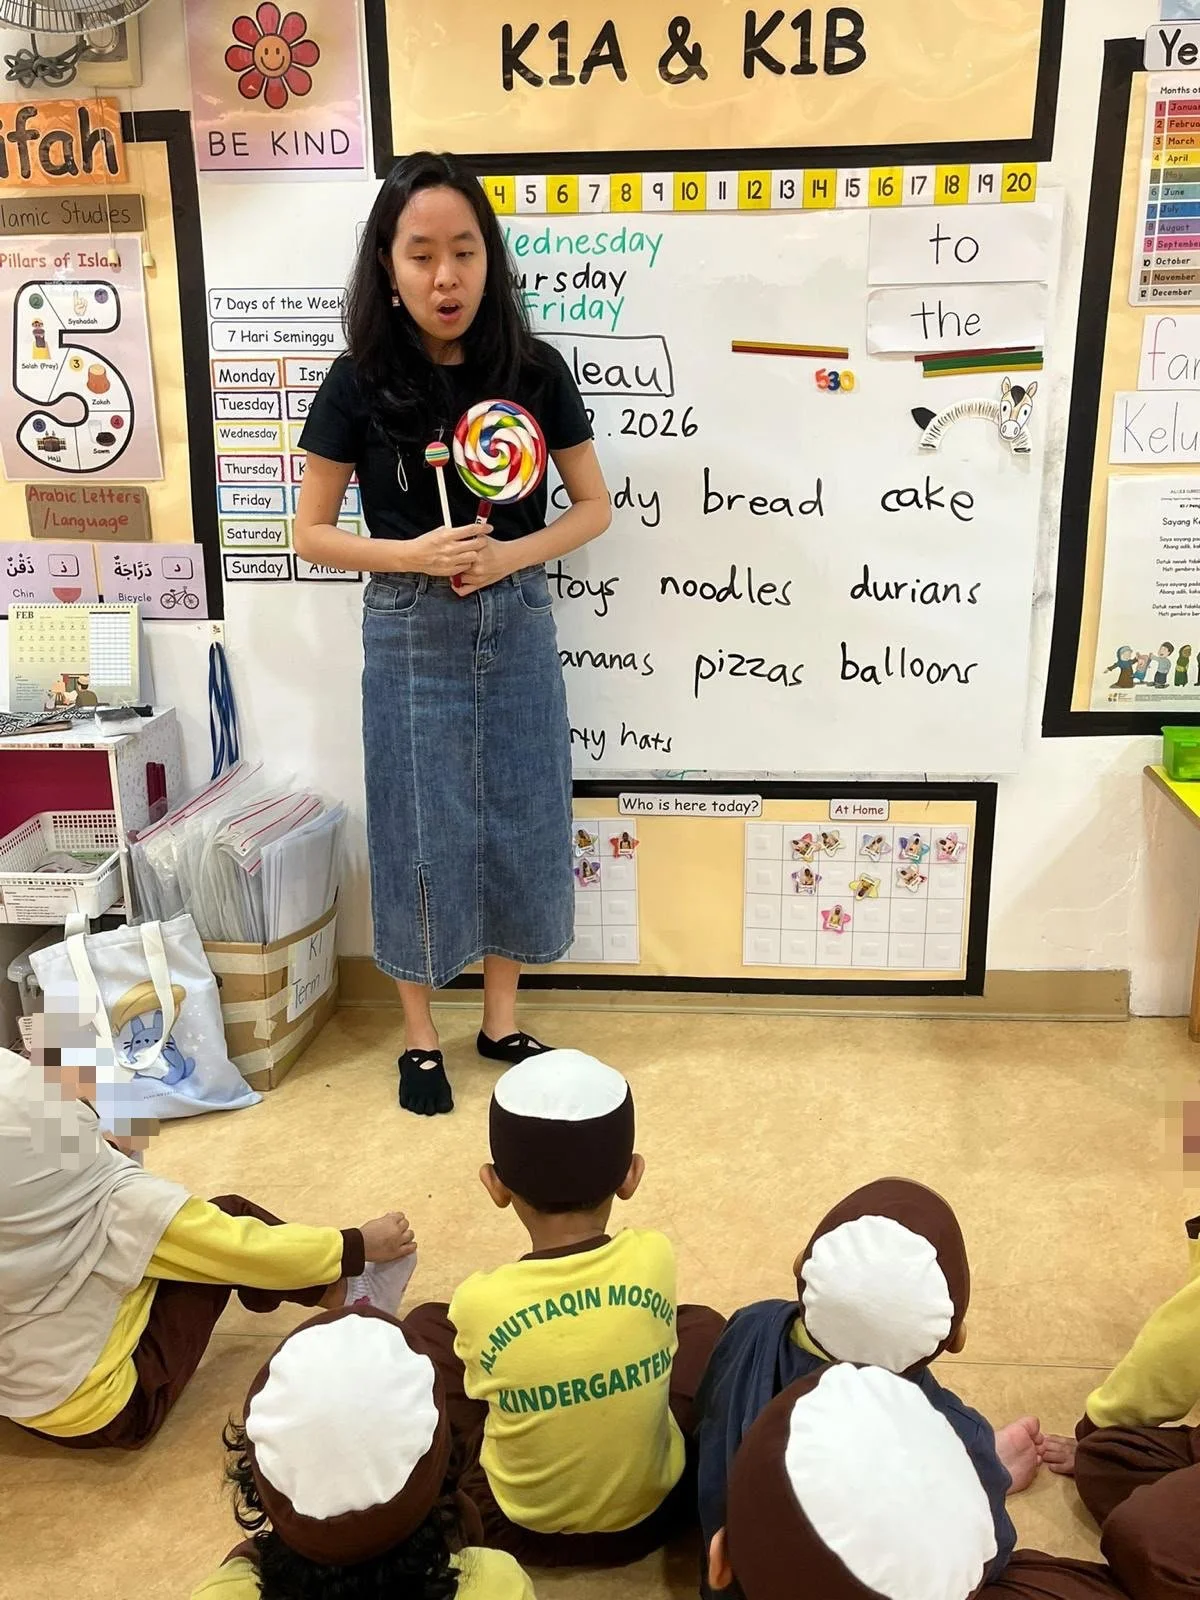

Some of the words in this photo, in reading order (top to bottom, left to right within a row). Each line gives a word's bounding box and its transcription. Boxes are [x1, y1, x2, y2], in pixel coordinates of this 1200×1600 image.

[502, 20, 628, 91] K1A
[658, 15, 708, 84] &
[743, 7, 867, 79] K1B
[1159, 28, 1199, 67] Ye
[1160, 86, 1190, 95] Months
[1157, 120, 1162, 128] 2
[208, 131, 249, 156] BE
[271, 129, 350, 156] KIND
[1155, 137, 1161, 145] 3
[1168, 137, 1195, 145] March
[1167, 154, 1188, 164] April
[494, 185, 505, 204] 4
[525, 185, 537, 204] 5
[557, 184, 569, 204] 6
[588, 183, 601, 203] 7
[620, 183, 632, 202] 8
[653, 182, 663, 201] 9
[681, 181, 698, 201] 10
[718, 180, 726, 200] 11
[747, 180, 762, 200] 12
[779, 179, 795, 200] 13
[812, 180, 827, 198] 14
[845, 178, 860, 198] 15
[877, 176, 893, 196] 16
[910, 176, 927, 195] 17
[944, 174, 960, 194] 18
[978, 173, 993, 193] 19
[1006, 172, 1031, 192] 20
[1151, 188, 1157, 196] 6
[1163, 188, 1185, 196] June
[1160, 224, 1190, 233] August
[504, 226, 663, 268] ednesday
[929, 223, 979, 264] to
[0, 252, 46, 268] Pillars
[54, 252, 71, 268] of
[507, 262, 627, 297] ursday
[1154, 273, 1196, 282] November
[1152, 288, 1192, 297] December
[213, 297, 222, 310] 7
[227, 297, 258, 313] Days
[262, 296, 275, 310] of
[281, 297, 303, 310] the
[307, 296, 344, 310] Week
[521, 291, 625, 332] Friday
[68, 317, 98, 326] Syahadah
[910, 300, 981, 339] the
[228, 330, 236, 343] 7
[241, 330, 269, 343] Hari
[273, 330, 334, 347] Seminggu
[219, 368, 275, 386] Monday
[299, 367, 328, 382] Isni
[573, 346, 663, 392] leau
[219, 397, 274, 414] Tuesday
[220, 428, 278, 440] Wednesday
[224, 463, 278, 477] Thursday
[28, 486, 77, 503] Arabic
[83, 487, 141, 504] Letters
[232, 494, 271, 508] Friday
[551, 476, 660, 527] cdy
[703, 467, 824, 518] bread
[880, 475, 975, 521] cake
[1162, 517, 1191, 527] Sayang
[227, 528, 282, 541] Saturday
[174, 563, 181, 572] د
[232, 560, 283, 576] Sunday
[12, 588, 35, 598] Chin
[547, 560, 620, 617] toys
[660, 564, 792, 606] noodles
[850, 564, 982, 606] durians
[118, 592, 152, 604] Bicycle
[16, 610, 34, 619] FEB
[559, 649, 655, 676] ananas
[694, 648, 806, 699] pizzas
[840, 641, 979, 686] balloons
[570, 727, 606, 761] rty
[620, 722, 672, 753] hats
[622, 798, 654, 812] Who
[658, 798, 670, 812] is
[675, 799, 707, 812] here
[711, 799, 759, 815] today?
[835, 805, 849, 815] At
[852, 805, 884, 816] Home
[292, 973, 320, 1009] Term
[479, 1286, 602, 1376] AL-MUTTAQIN
[608, 1284, 676, 1328] MOSQUE
[498, 1346, 673, 1414] KINDERGARTEN
